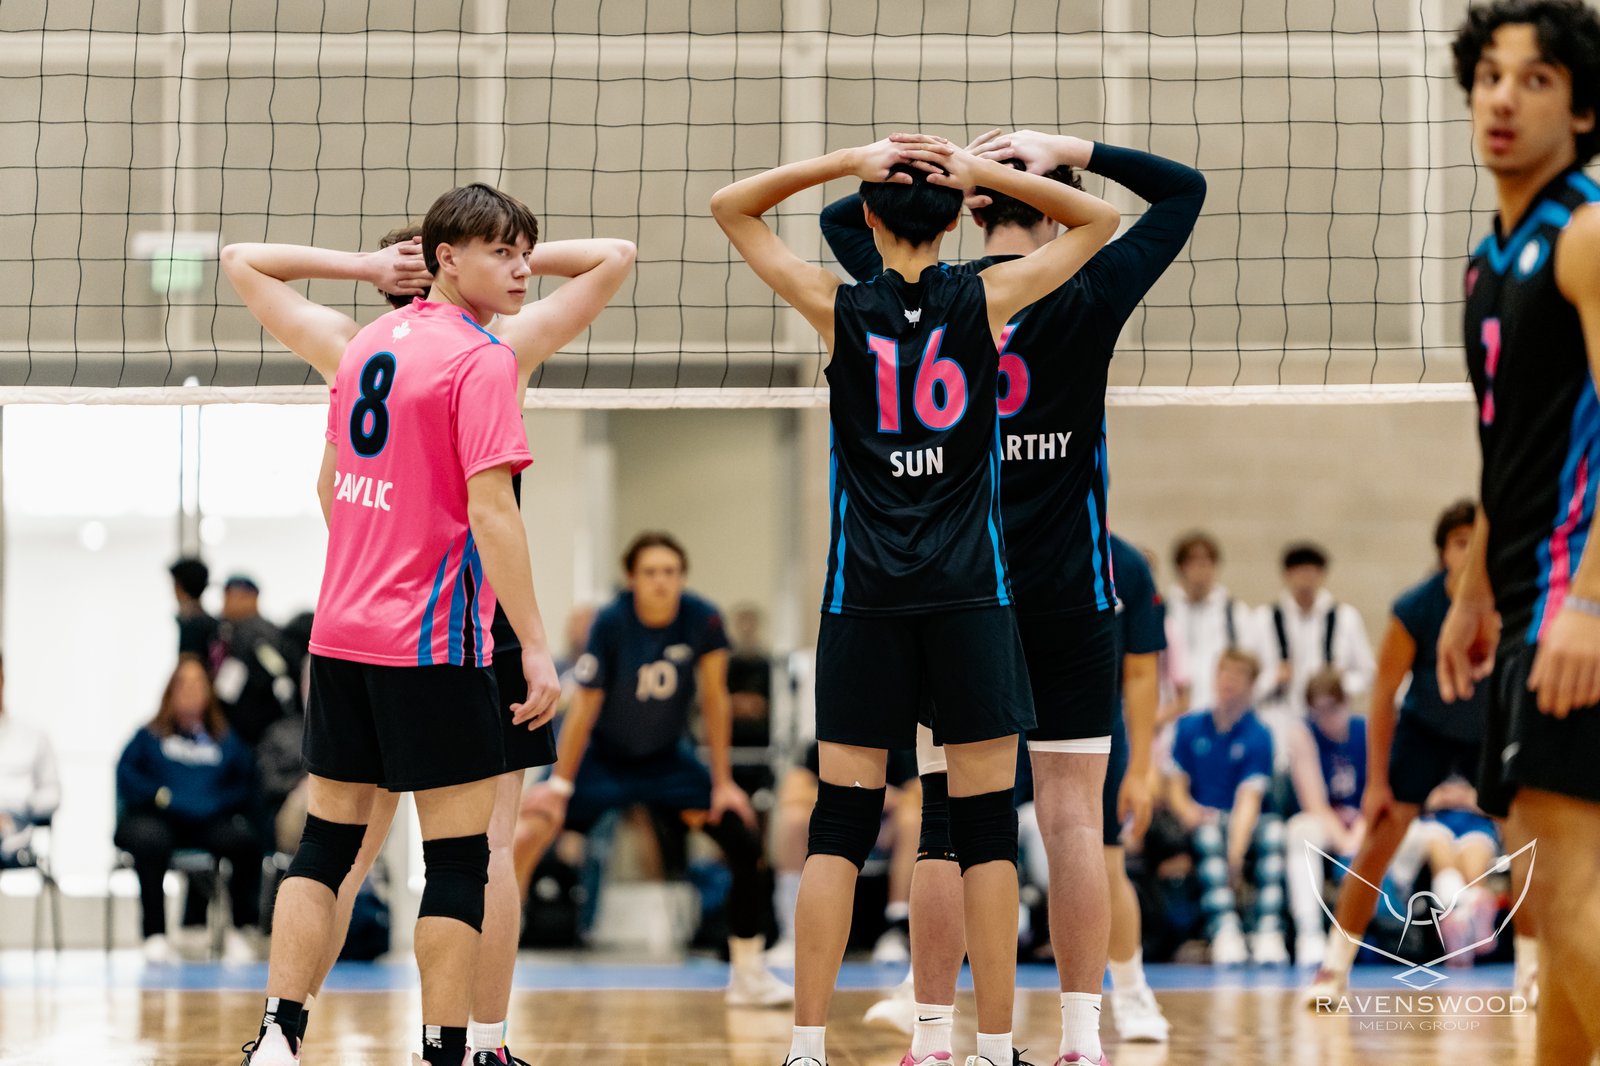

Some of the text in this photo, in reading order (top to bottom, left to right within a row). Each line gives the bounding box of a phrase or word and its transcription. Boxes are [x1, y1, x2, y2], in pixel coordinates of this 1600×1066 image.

[866, 323, 968, 433] 16
[349, 351, 396, 458] 8
[889, 446, 944, 477] SUN
[1001, 431, 1073, 461] RTHY
[636, 660, 678, 702] 10
